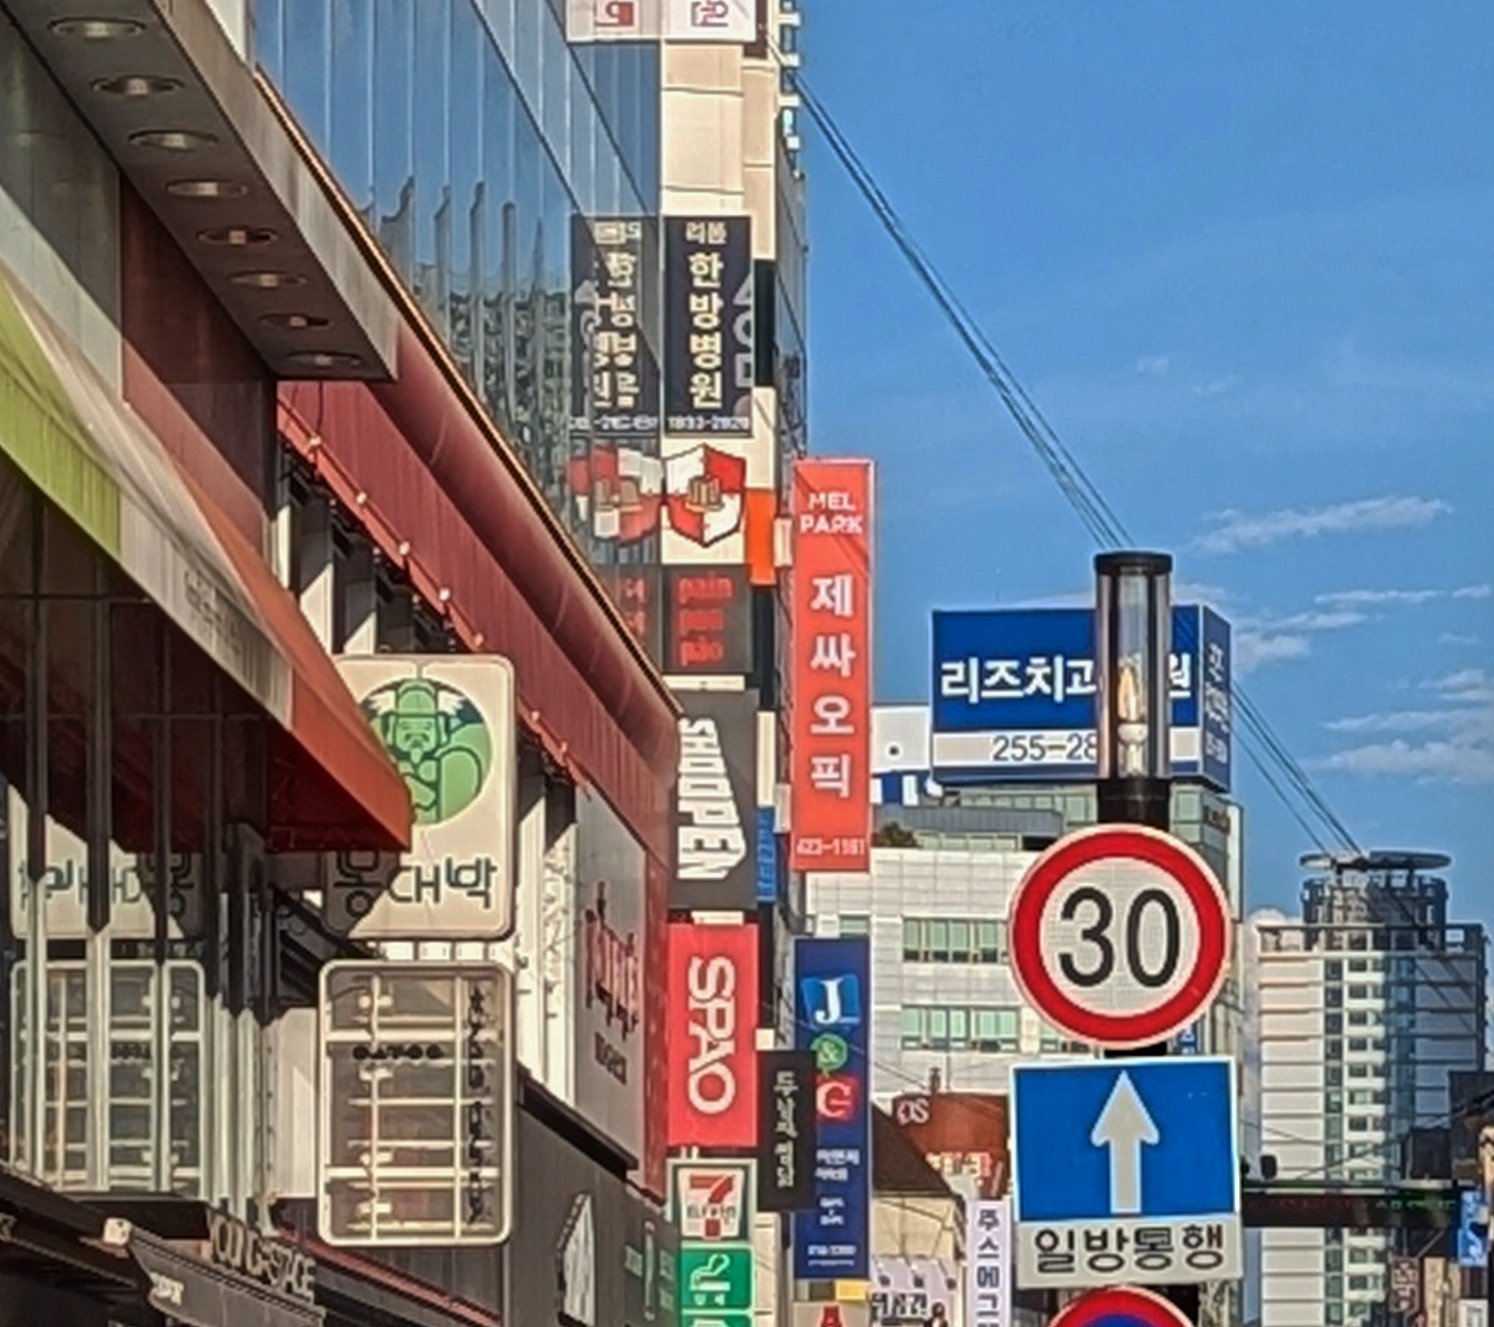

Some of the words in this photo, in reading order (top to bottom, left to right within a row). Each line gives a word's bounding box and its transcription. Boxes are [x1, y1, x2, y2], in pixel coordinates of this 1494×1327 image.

[688, 251, 724, 411] 한방병원
[800, 516, 861, 534] PARK
[808, 493, 856, 510] MEL
[810, 574, 856, 797] 제싸오픽
[992, 734, 1098, 762] 255-28
[1058, 886, 1180, 988] 30
[688, 956, 736, 1114] SPAO
[1035, 1223, 1224, 1273] 일방통행
